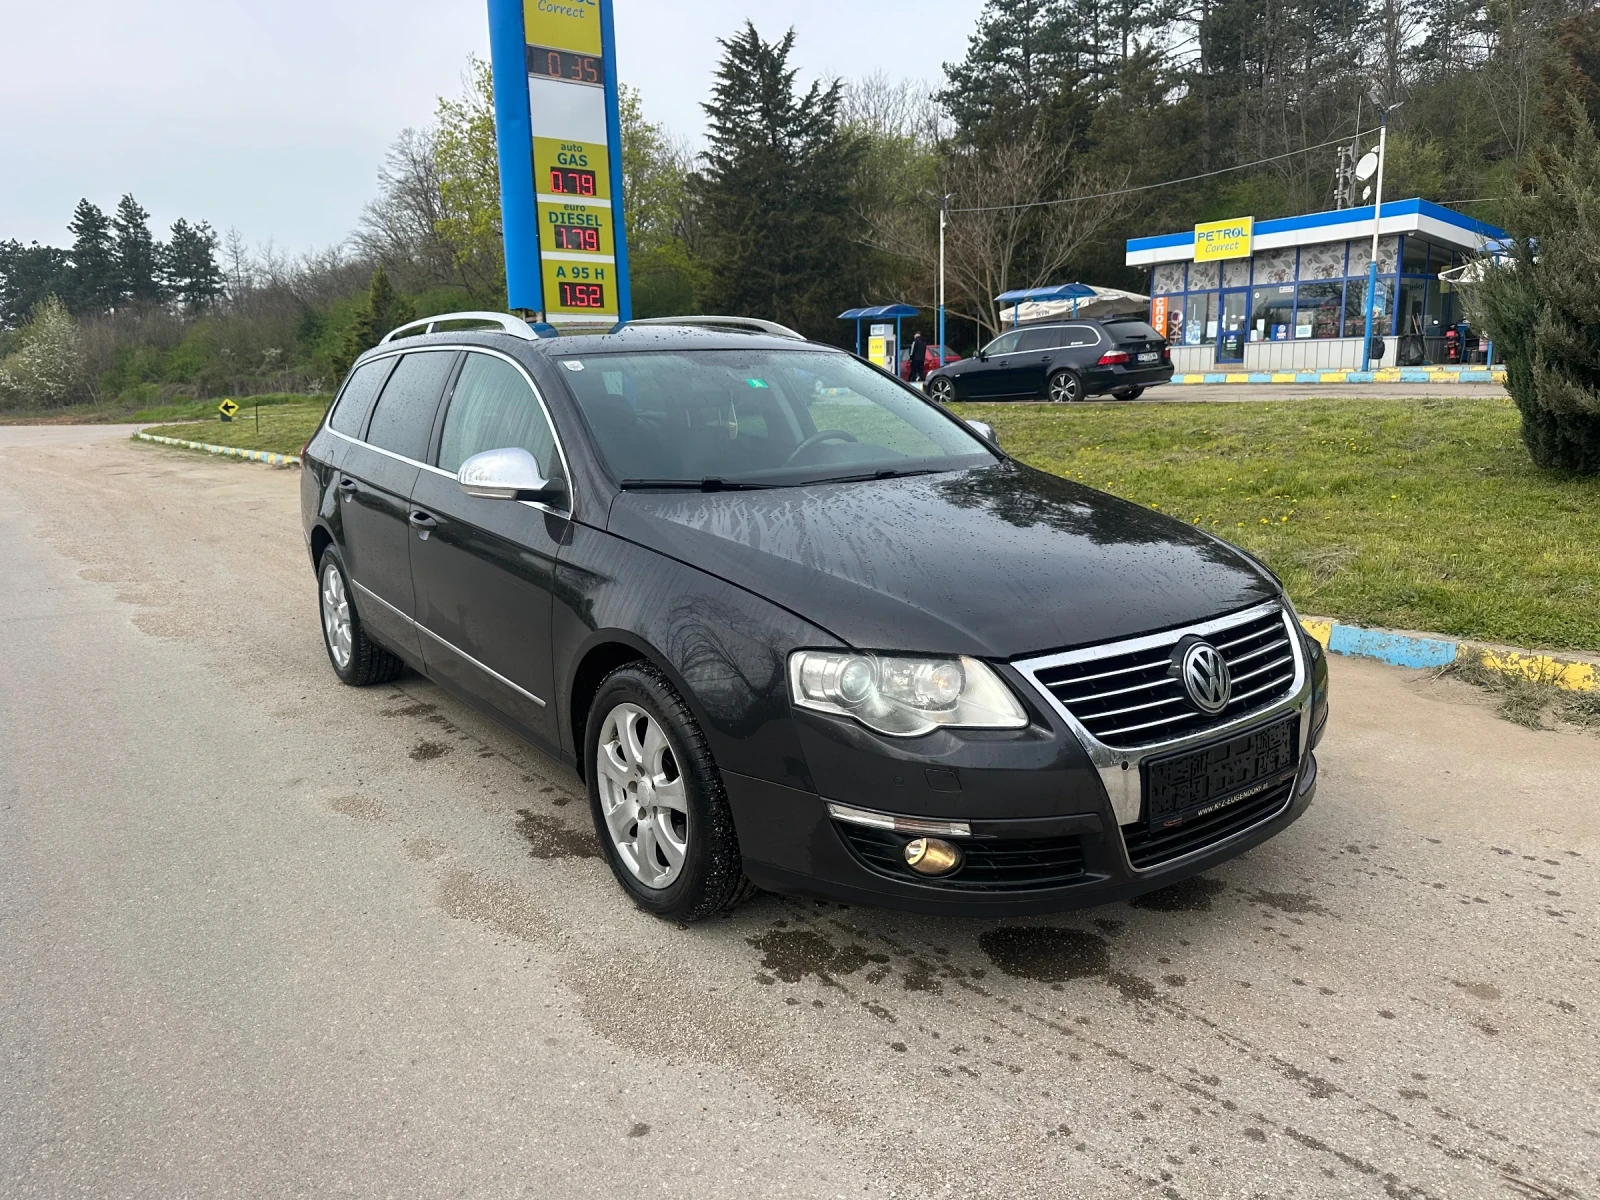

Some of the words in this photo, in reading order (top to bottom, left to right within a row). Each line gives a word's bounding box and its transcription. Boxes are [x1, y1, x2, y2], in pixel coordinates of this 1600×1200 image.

[538, 0, 585, 19] Correct
[560, 143, 583, 153] auto
[557, 152, 588, 167] GAS
[550, 170, 594, 196] 0.79
[563, 203, 586, 212] euro
[548, 211, 603, 227] DIESEL
[560, 227, 598, 251] 1.79
[1197, 227, 1249, 243] PETROL
[1205, 241, 1239, 254] Correct
[556, 265, 567, 278] A
[571, 267, 590, 279] 95
[595, 269, 605, 280] H
[564, 284, 601, 308] 1.52
[1155, 297, 1165, 334] СПОР
